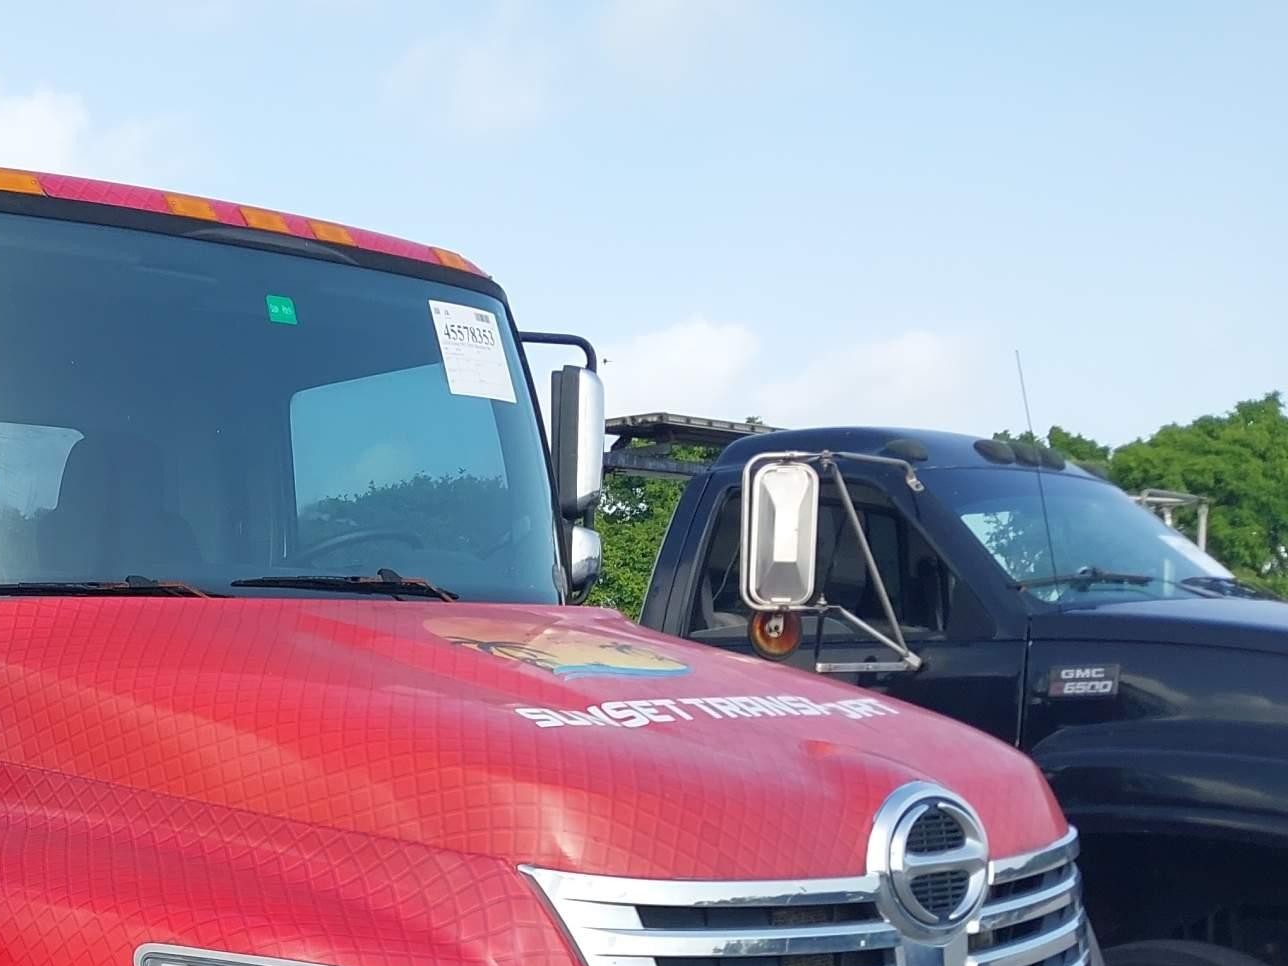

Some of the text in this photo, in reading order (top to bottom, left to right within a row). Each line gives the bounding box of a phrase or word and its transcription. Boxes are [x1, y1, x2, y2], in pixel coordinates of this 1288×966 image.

[443, 323, 496, 346] 45578353
[1060, 667, 1105, 680] GMC
[1062, 680, 1113, 694] 6500
[514, 698, 694, 729] SUNSET
